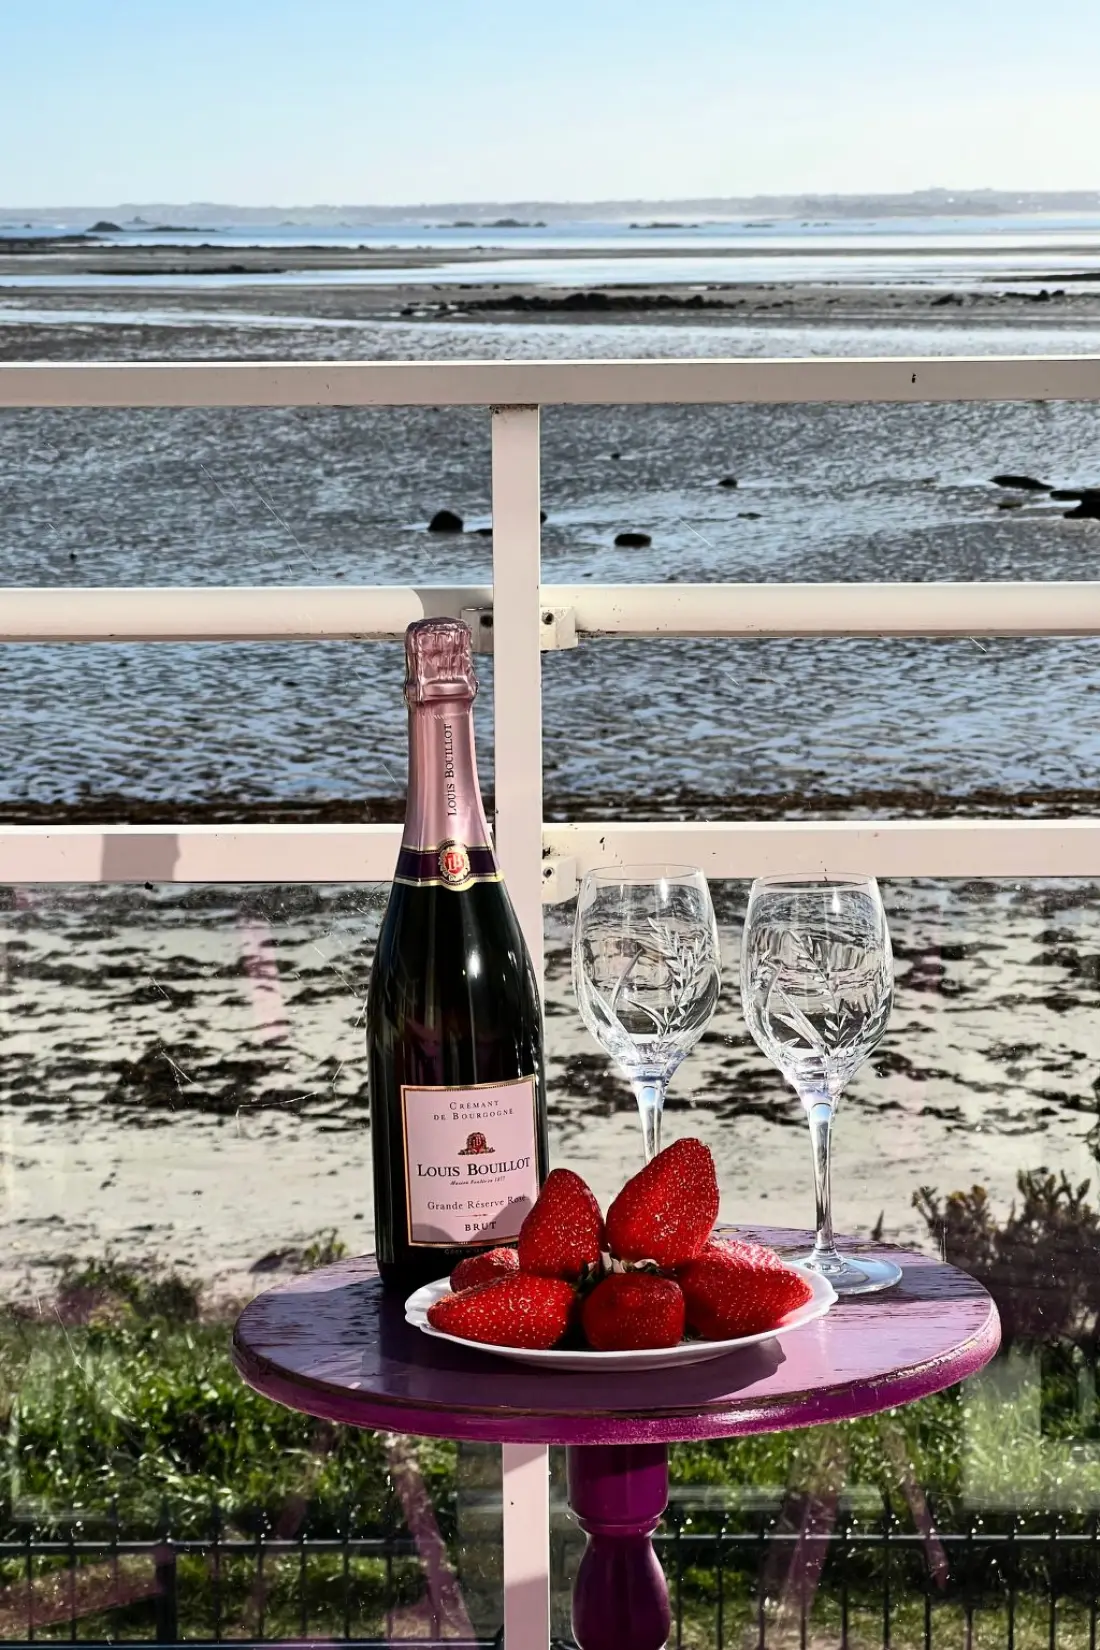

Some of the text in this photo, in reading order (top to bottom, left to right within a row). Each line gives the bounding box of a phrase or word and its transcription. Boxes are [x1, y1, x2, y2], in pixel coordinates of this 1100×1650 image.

[444, 724, 457, 816] LOUIS BOUILLOT
[452, 1108, 514, 1120] BOURGOGNE
[417, 1157, 530, 1177] LOUIS BOUILLOT
[427, 1201, 463, 1210] Grande
[467, 1199, 505, 1209] Réserve
[465, 1221, 496, 1231] BRUT
